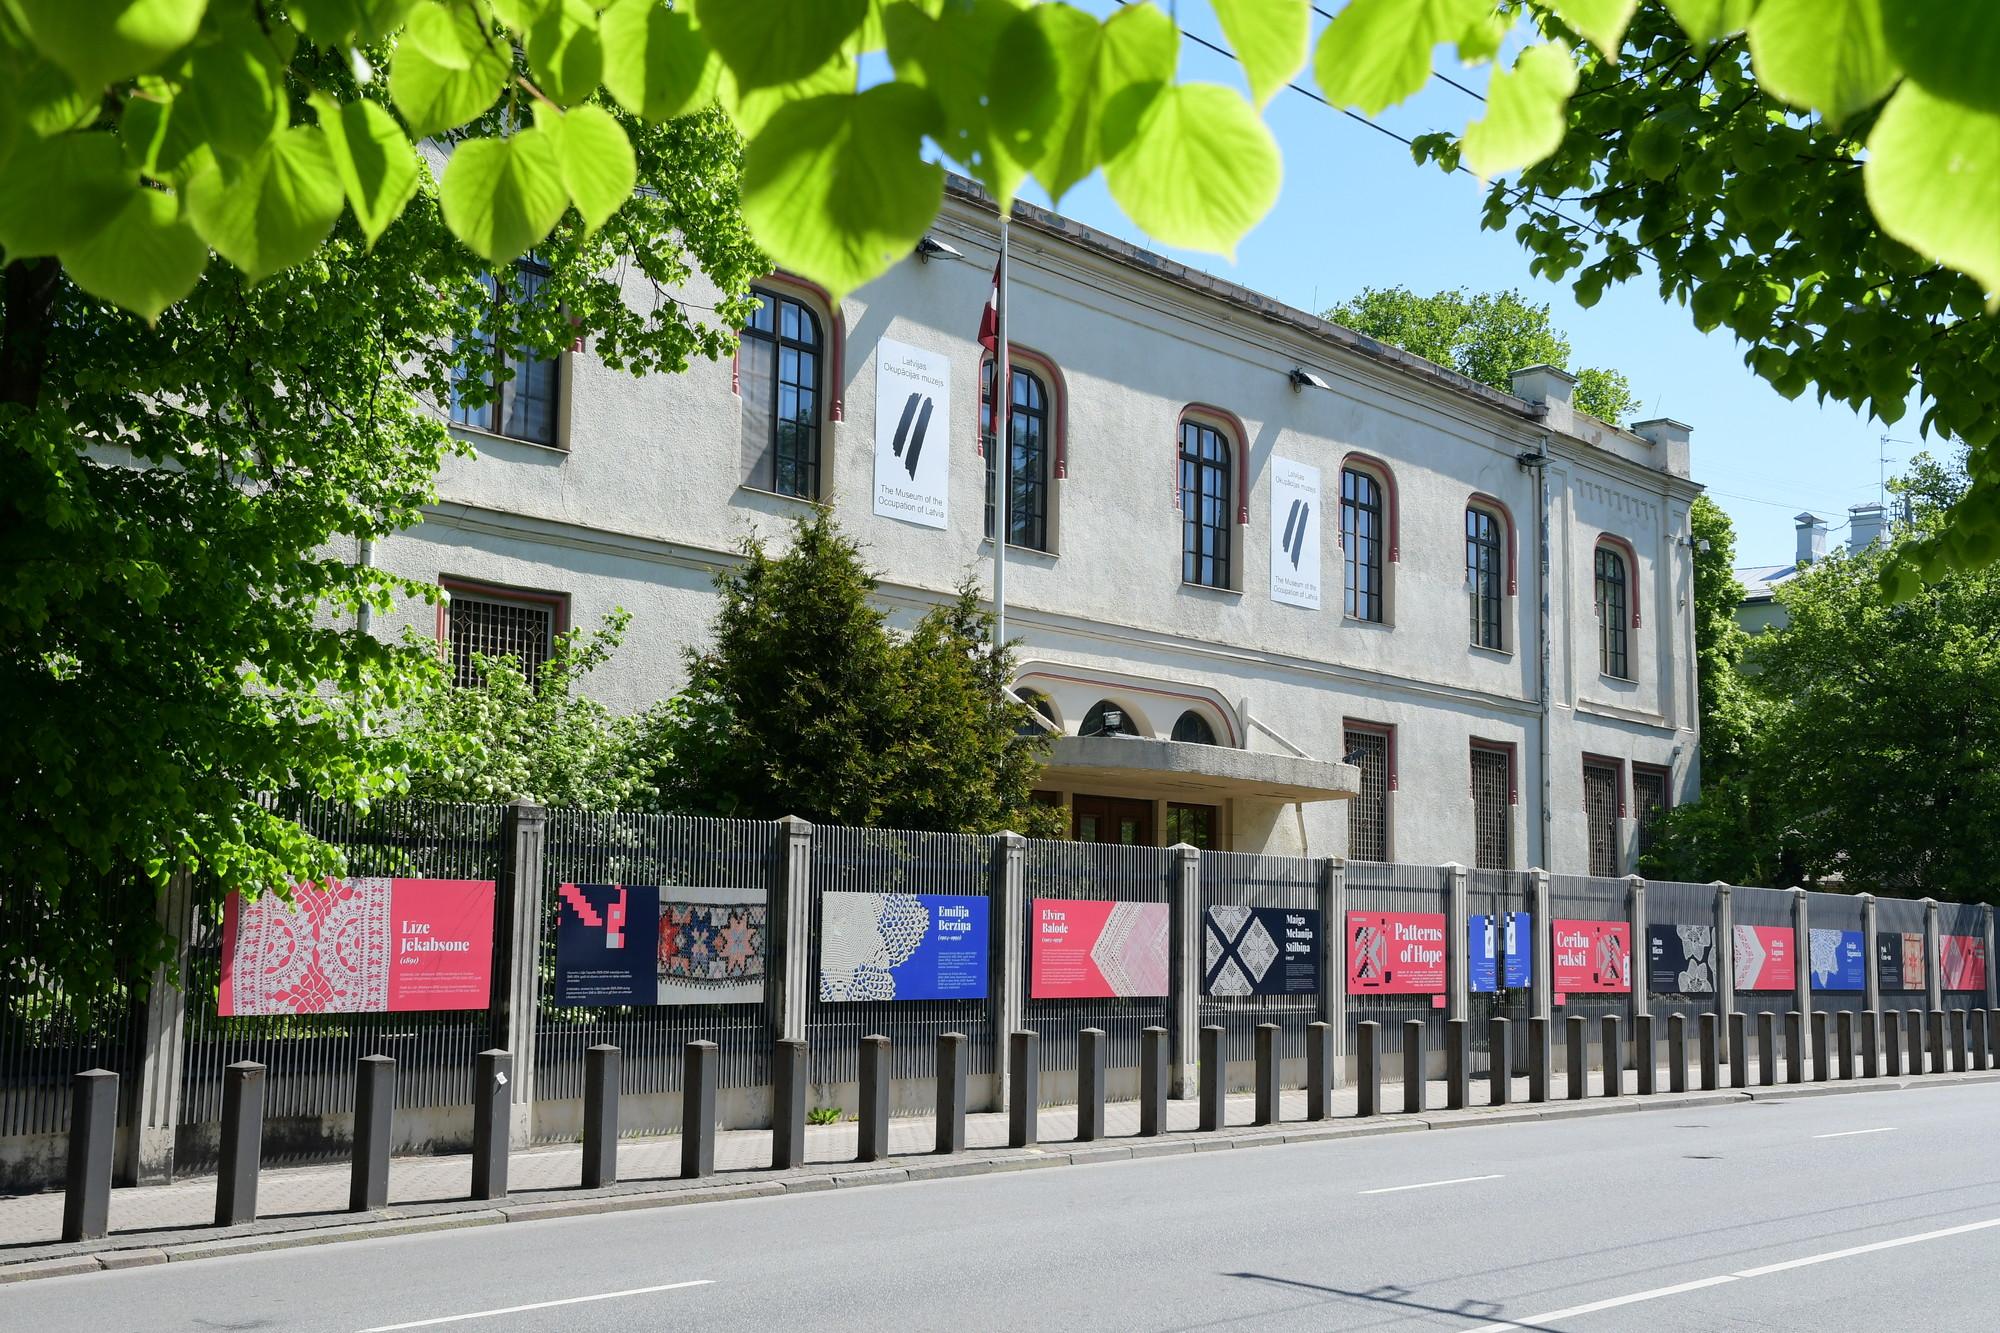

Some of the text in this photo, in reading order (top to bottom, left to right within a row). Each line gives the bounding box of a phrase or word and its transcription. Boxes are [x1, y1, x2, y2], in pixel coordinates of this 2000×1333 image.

[902, 356, 927, 370] Latvijas
[881, 484, 943, 507] The Museum of the
[878, 496, 945, 519] Occupation of Latvia
[402, 920, 431, 934] Līze
[938, 919, 972, 934] Bērziņa
[1042, 922, 1069, 934] Balode
[1286, 914, 1306, 927] Maiga
[1395, 922, 1442, 941] Patterns
[400, 937, 470, 954] Jēkabsone
[1400, 943, 1442, 968] of Hope
[1557, 948, 1587, 967] raksti
